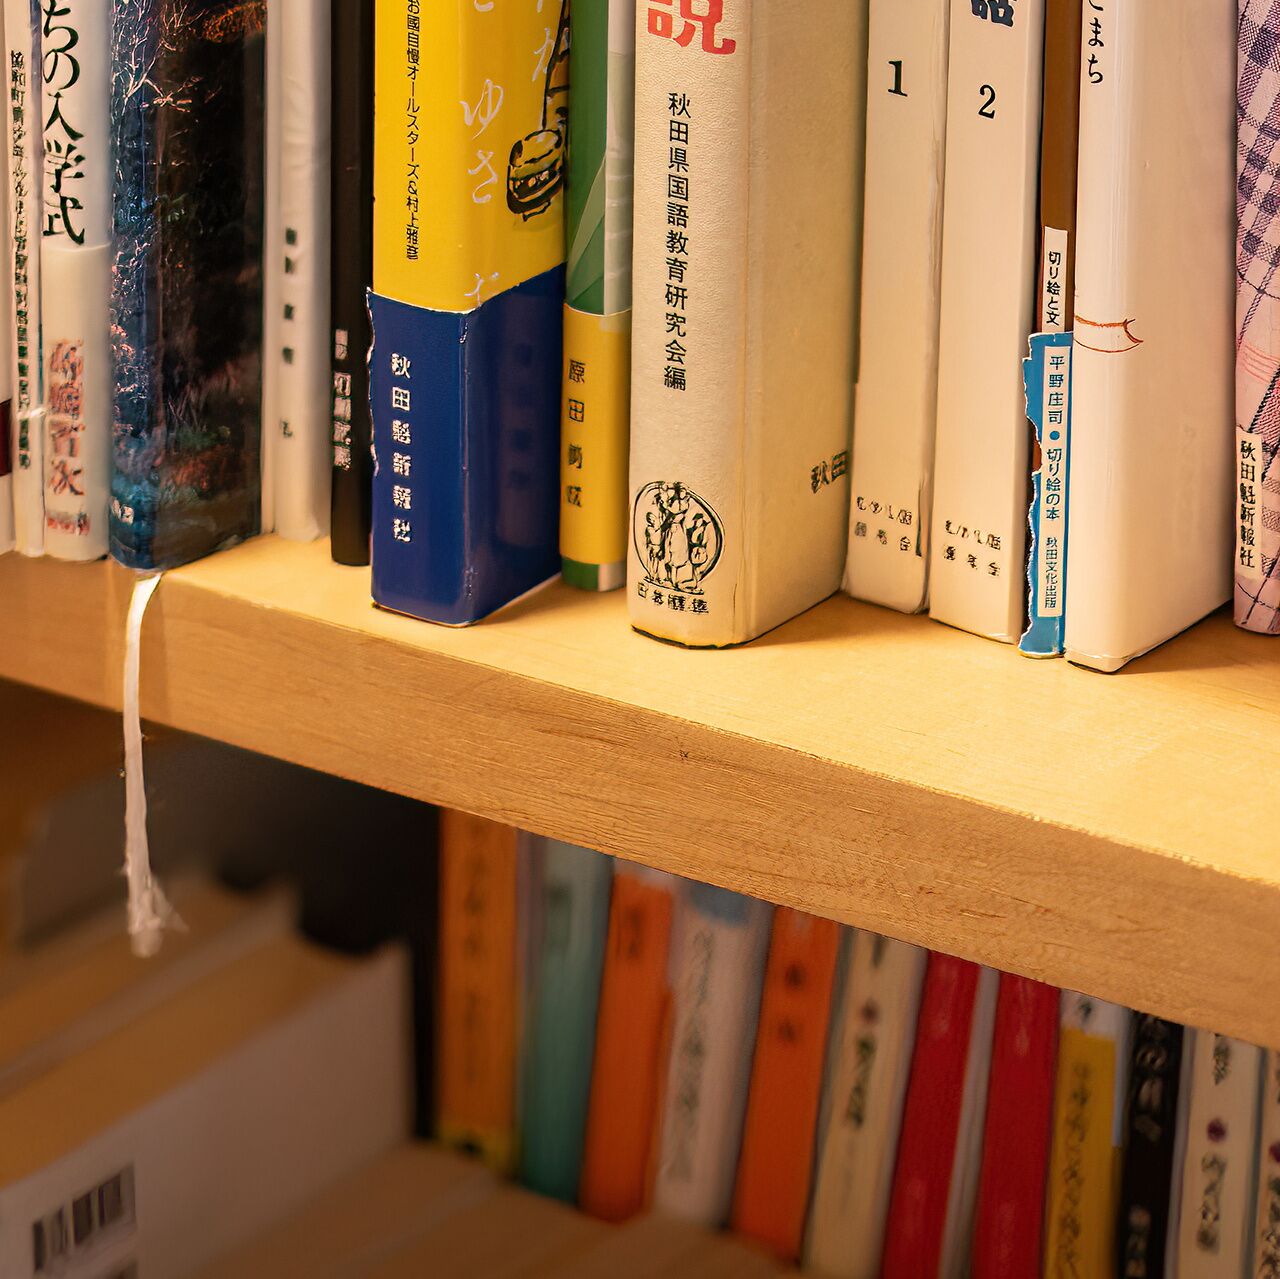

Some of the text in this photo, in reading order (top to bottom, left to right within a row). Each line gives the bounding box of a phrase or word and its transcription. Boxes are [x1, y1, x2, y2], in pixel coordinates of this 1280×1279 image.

[886, 60, 909, 97] 1
[978, 84, 997, 120] 2
[662, 91, 692, 392] 秋田県国語教育研究会編
[1045, 250, 1061, 327] 切り絵と文
[1044, 355, 1064, 609] 平野庄司 切り絵の本 秋田文化出版
